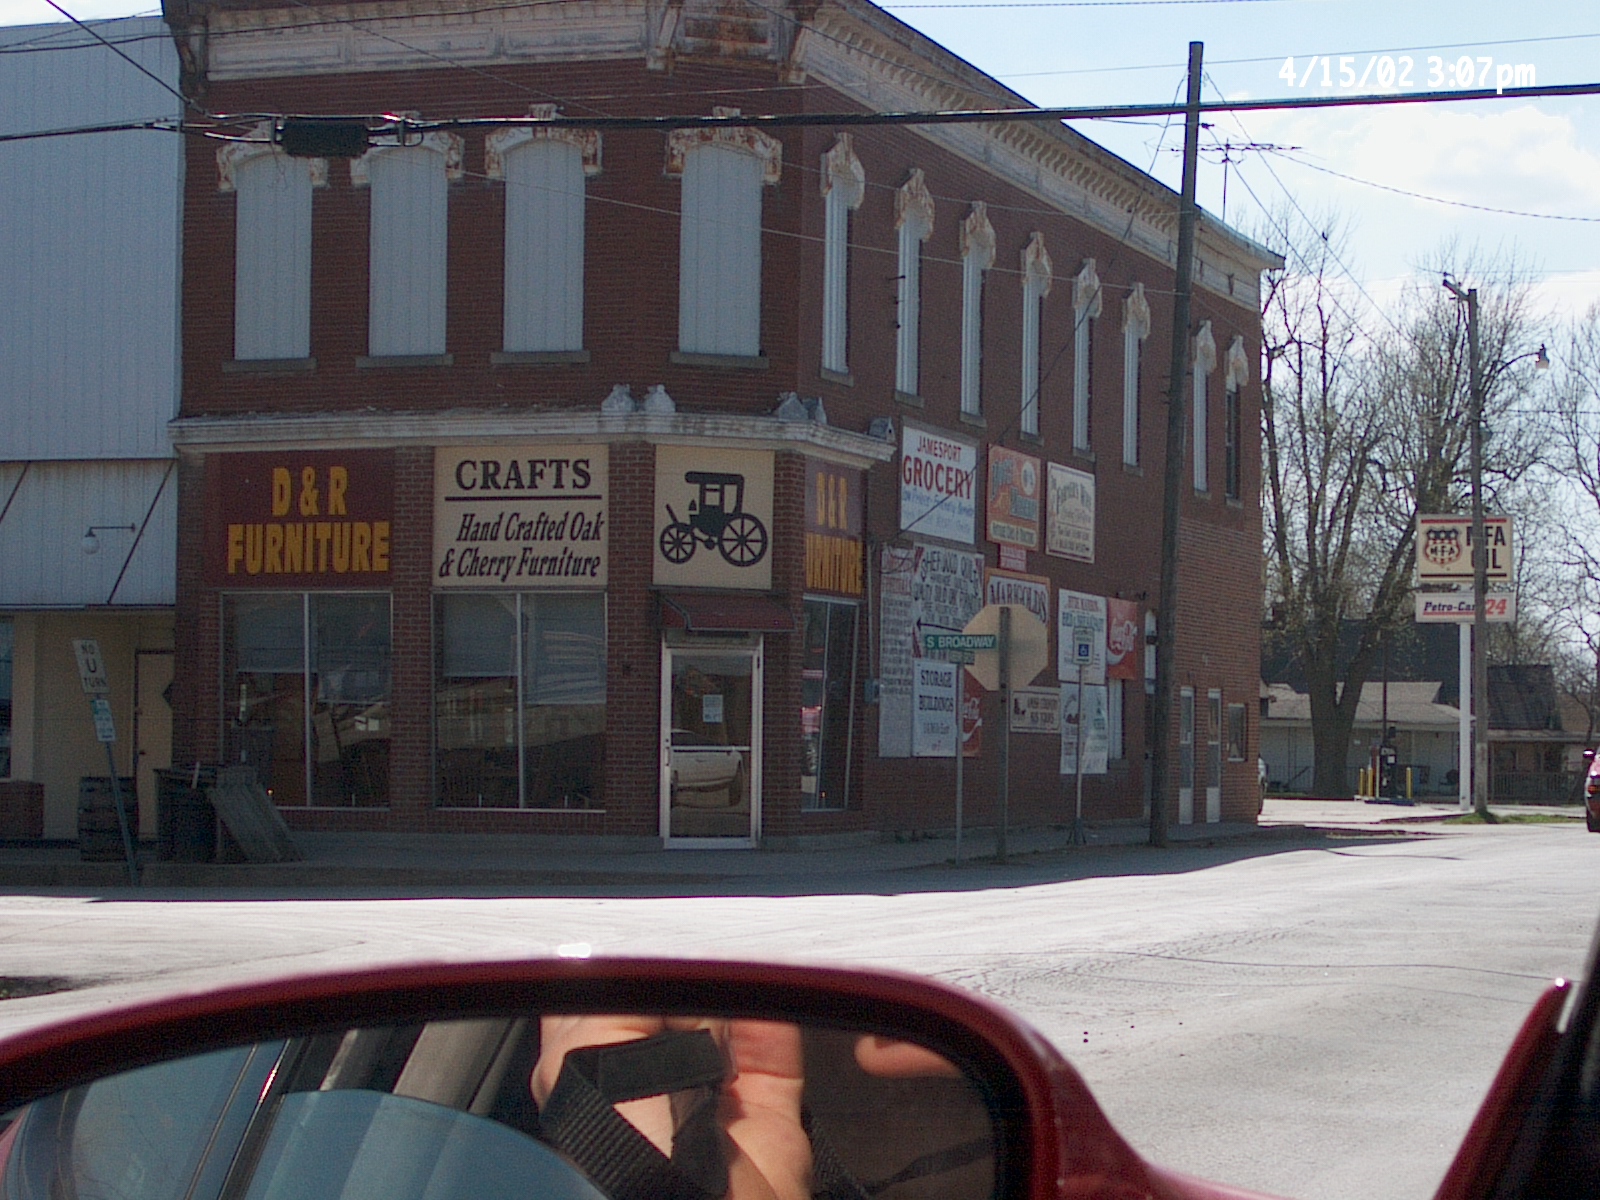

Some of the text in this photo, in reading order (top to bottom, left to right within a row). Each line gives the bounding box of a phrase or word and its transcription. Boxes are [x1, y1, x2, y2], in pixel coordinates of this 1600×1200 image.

[917, 436, 961, 462] JAMESPORT
[454, 459, 592, 491] CRAFTS
[903, 455, 974, 500] GROCERY
[271, 466, 349, 517] D & R
[456, 511, 605, 543] Hand Crafted Oak
[227, 521, 391, 575] FURNITURE
[438, 546, 601, 582] & Cherry Furniture
[804, 531, 863, 595] URNITURE
[1485, 599, 1507, 615] 24
[926, 636, 996, 649] S BROADWAY
[86, 658, 98, 673] U
[921, 669, 953, 688] STORAGE
[918, 694, 954, 712] BUILDINGS
